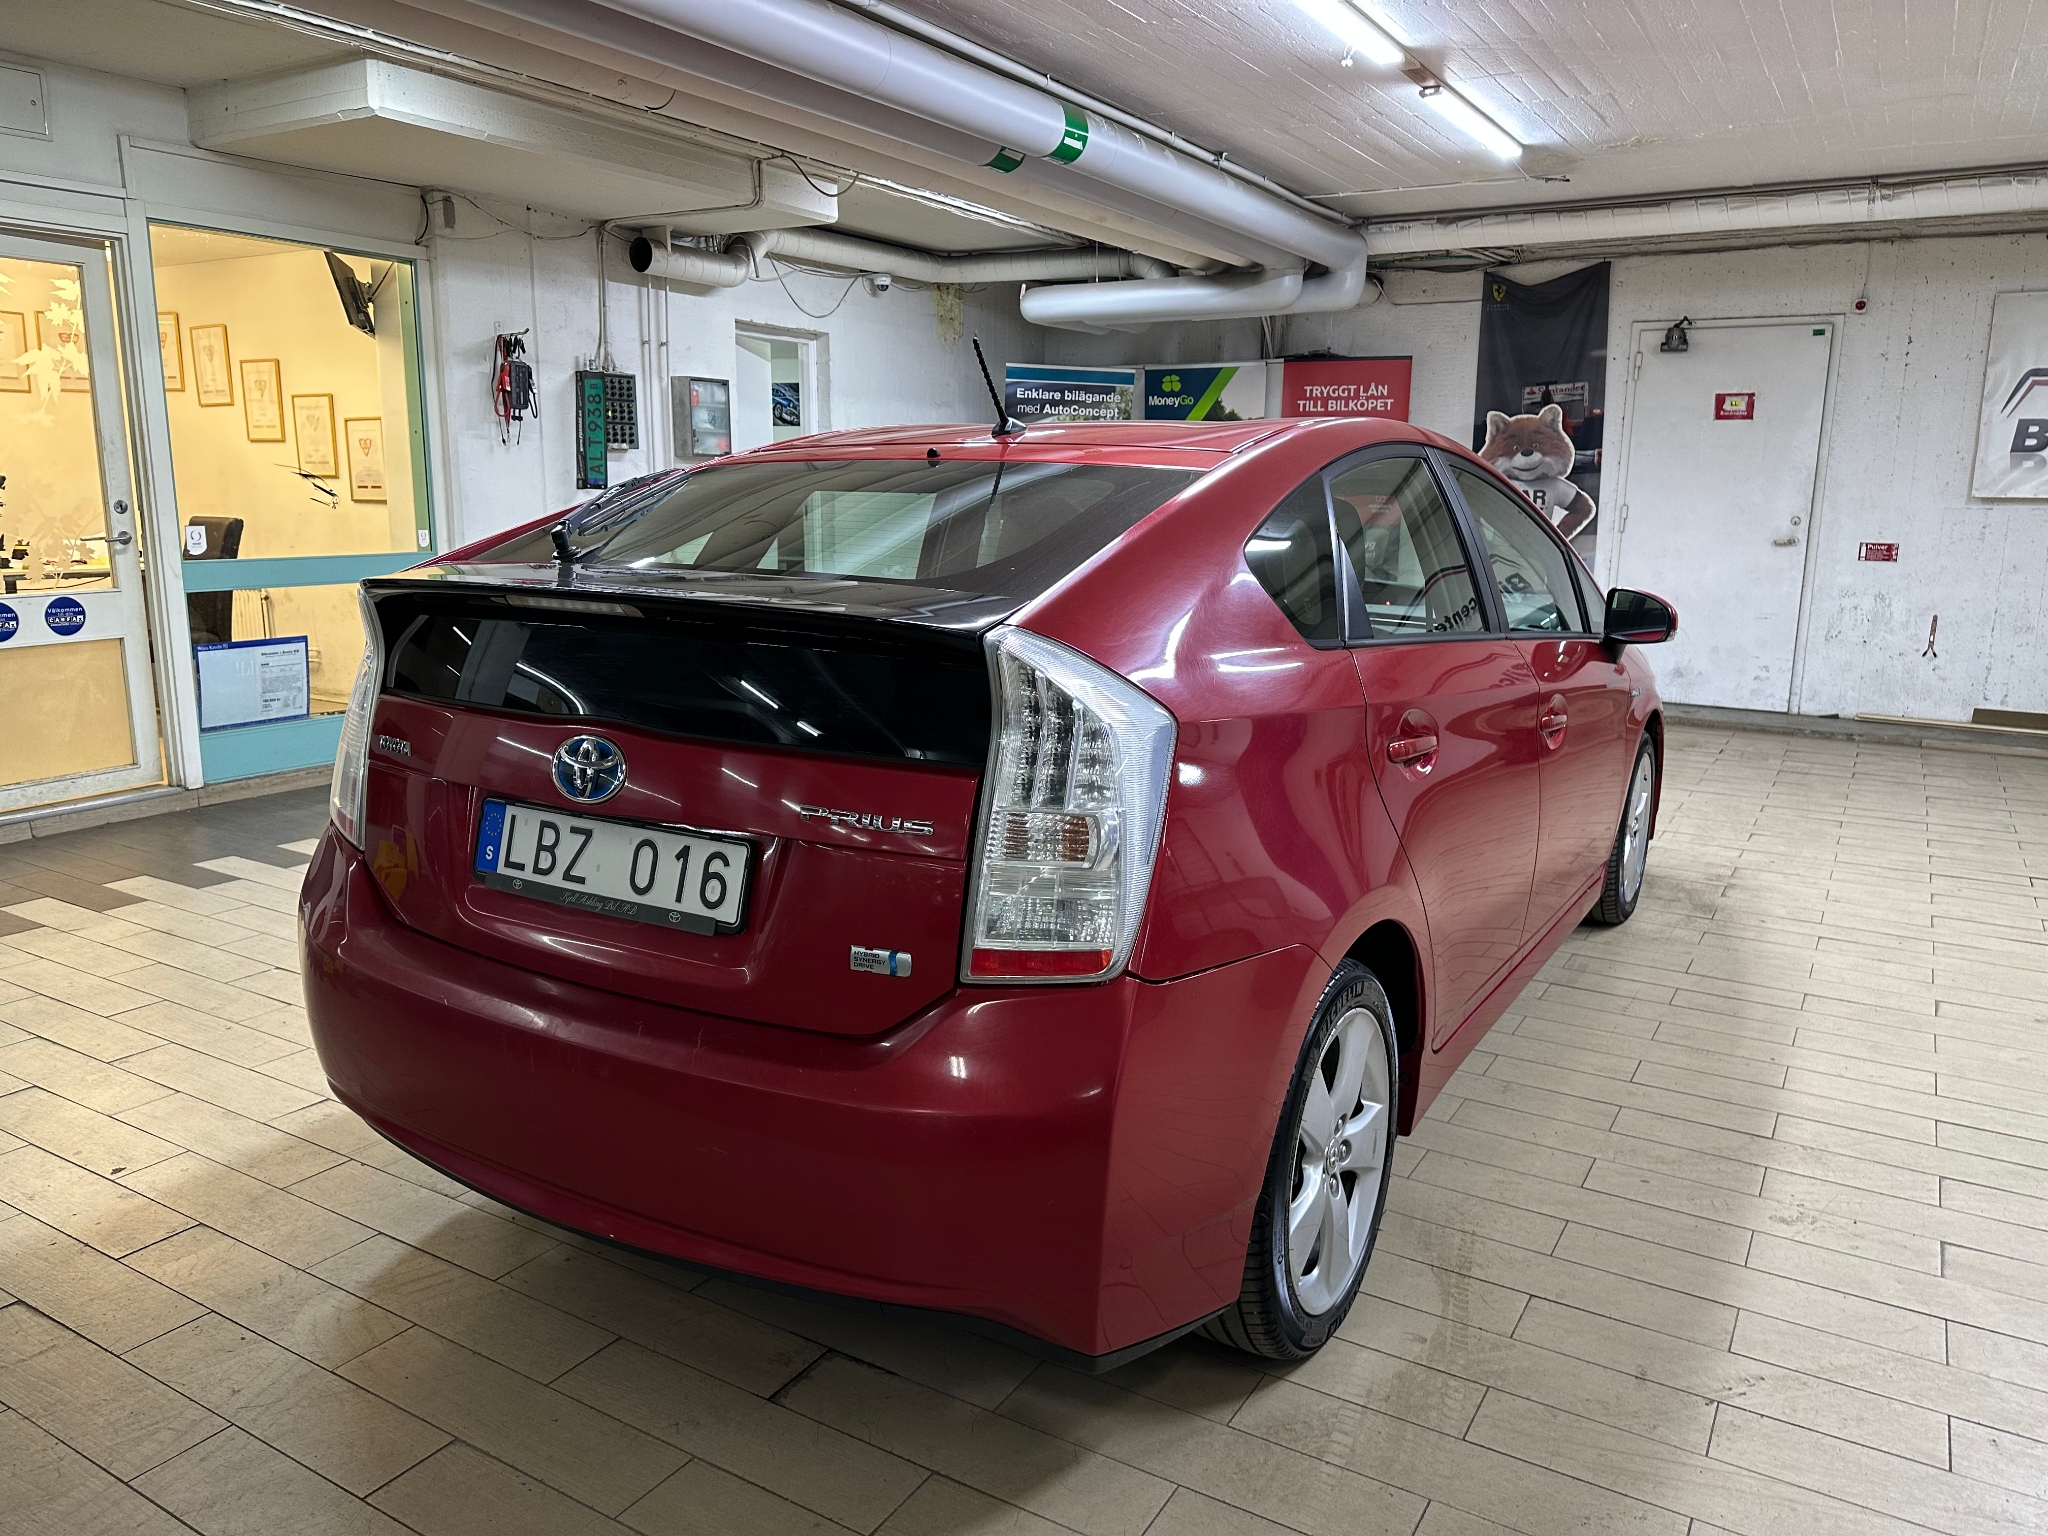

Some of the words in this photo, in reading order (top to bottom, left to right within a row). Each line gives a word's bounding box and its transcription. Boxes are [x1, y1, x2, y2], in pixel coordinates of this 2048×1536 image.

[1016, 387, 1061, 400] Enklare
[1064, 390, 1121, 403] bilägande
[1304, 385, 1357, 398] TRYGGT
[1359, 382, 1388, 397] LÅN
[1148, 394, 1194, 408] MoneyGo
[1297, 400, 1325, 412] TILL
[1327, 396, 1394, 411] BILKÖPET
[1017, 403, 1040, 414] med
[1043, 403, 1119, 418] AutoConcept
[800, 804, 934, 836] PRIUS
[485, 846, 494, 860] S
[503, 814, 594, 885] LBZ
[629, 838, 731, 910] 016
[853, 950, 880, 959] HYBRID
[853, 956, 886, 966] SYNERGY
[853, 962, 875, 970] DRIVE
[1319, 980, 1365, 1043] MICHELIN
